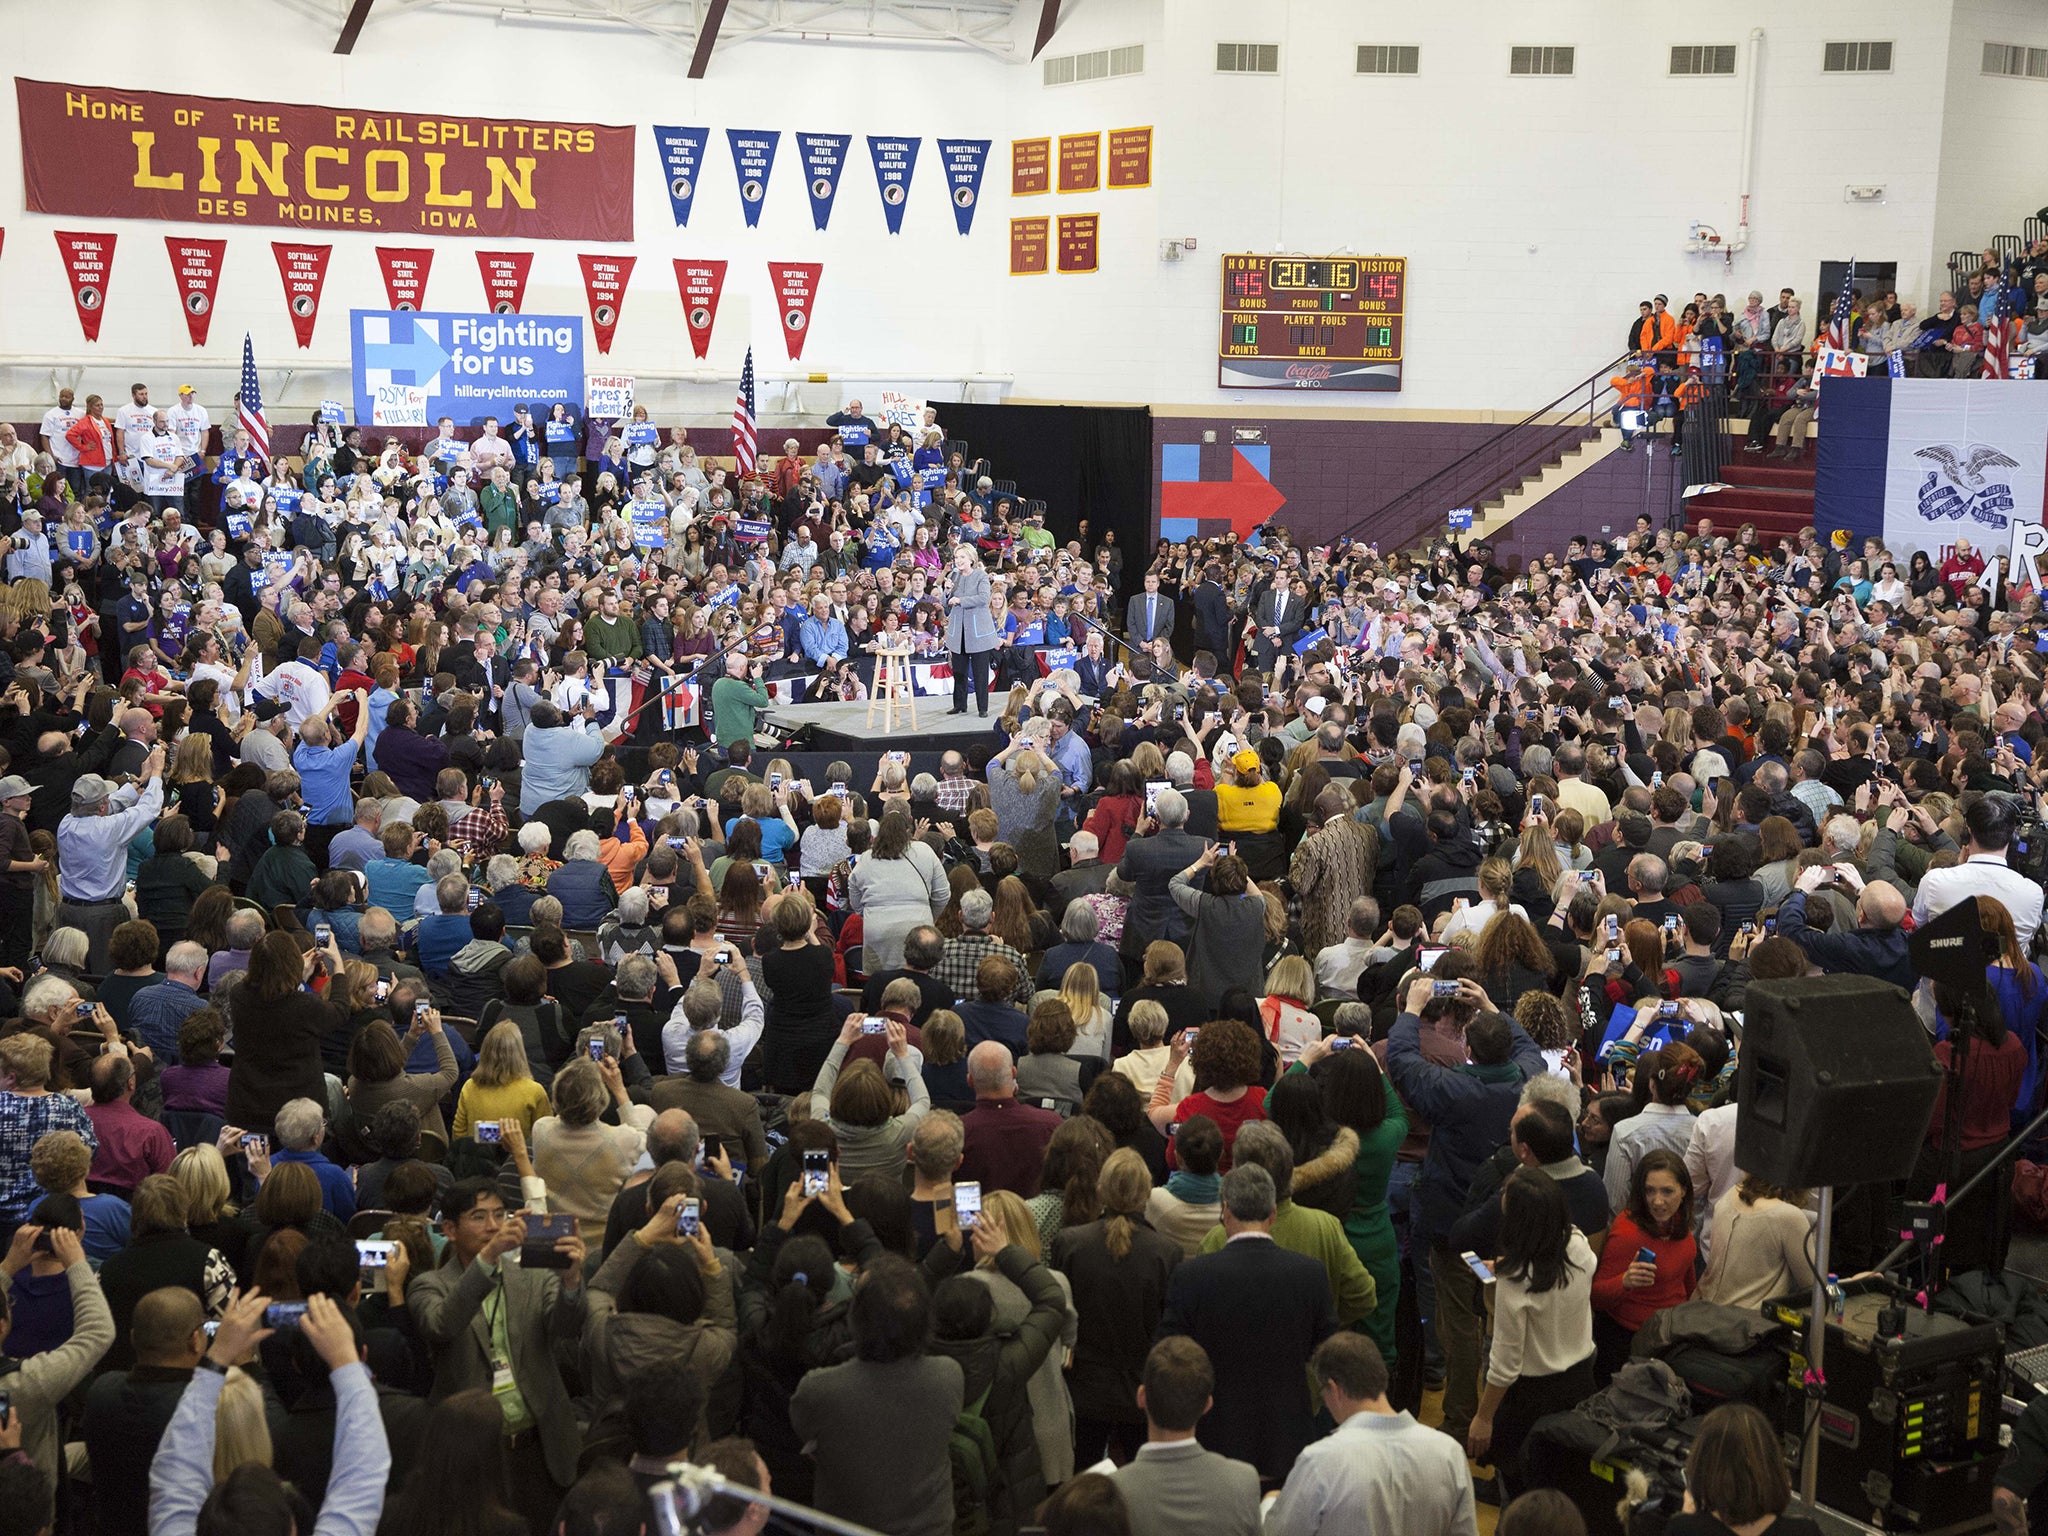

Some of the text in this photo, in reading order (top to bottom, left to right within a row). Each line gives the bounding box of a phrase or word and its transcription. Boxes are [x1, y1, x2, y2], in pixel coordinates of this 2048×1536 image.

[174, 109, 205, 126] OF
[232, 113, 281, 134] THE
[335, 116, 597, 154] RAILSPLITTERS
[665, 137, 698, 147] BASKETBALL
[737, 140, 770, 149] BASKETBALL
[806, 138, 840, 147] BASKETBALL
[673, 147, 689, 156] STATE
[746, 149, 761, 158] STATE
[815, 148, 832, 156] STATE
[946, 146, 982, 154] BASKETBALL
[668, 156, 694, 165] QUALIFIER
[809, 156, 837, 165] QUALIFIER
[884, 152, 901, 160] STATE
[955, 155, 973, 163] STATE
[741, 158, 767, 167] QUALIFIER
[879, 161, 907, 169] QUALIFIER
[132, 131, 538, 209] LINCOLN
[950, 163, 978, 172] QUALIFIER
[198, 199, 478, 230] DES MOINES, IOWA
[72, 241, 102, 251] SOFTBALL
[79, 252, 97, 260] STATE
[180, 248, 212, 258] SOFTBALL
[287, 252, 318, 261] SOFTBALL
[73, 261, 104, 270] QUALIFIER
[188, 258, 206, 267] STATE
[293, 262, 312, 270] STATE
[391, 260, 418, 269] SOFTBALL
[490, 261, 516, 269] SOFTBALL
[1228, 258, 1266, 270] HOME
[1361, 261, 1402, 273] VISITOR
[182, 268, 213, 277] QUALIFIER
[593, 263, 620, 273] SOFTBALL
[687, 268, 714, 277] SOFTBALL
[78, 273, 100, 282] 2003
[288, 271, 318, 280] QUALIFIER
[397, 270, 413, 278] STATE
[496, 270, 513, 278] STATE
[598, 272, 615, 281] STATE
[782, 270, 809, 279] SOFTBALL
[188, 280, 207, 289] 2001
[392, 279, 419, 288] QUALIFIER
[491, 279, 518, 287] QUALIFIER
[592, 281, 619, 290] QUALIFIER
[692, 277, 708, 285] STATE
[787, 279, 804, 287] STATE
[1235, 273, 1263, 295] 45
[293, 283, 314, 292] 2000
[687, 286, 714, 295] QUALIFIER
[1369, 275, 1398, 298] 45
[782, 288, 809, 296] QUALIFIER
[1239, 298, 1267, 309] BONUS
[1292, 300, 1319, 308] PERIOD
[1359, 300, 1386, 311] BONUS
[1233, 314, 1258, 324] FOULS
[1284, 315, 1347, 326] PLAYER FOULS
[1367, 317, 1392, 327] FOULS
[452, 319, 573, 354] Fighting
[1229, 345, 1259, 355] POINTS
[1299, 346, 1326, 356] MATCH
[1363, 348, 1393, 357] POINTS
[452, 348, 534, 375] for us
[379, 387, 424, 406] DSM for
[454, 385, 567, 401] hillaryclinton.com
[625, 391, 631, 400] 2
[883, 392, 906, 404] HILL
[383, 408, 424, 424] HILLARY
[1920, 488, 1948, 510] LIBERTIES
[632, 502, 665, 511] Fighting
[261, 551, 292, 561] Fightin
[1929, 937, 1965, 948] SHURE
